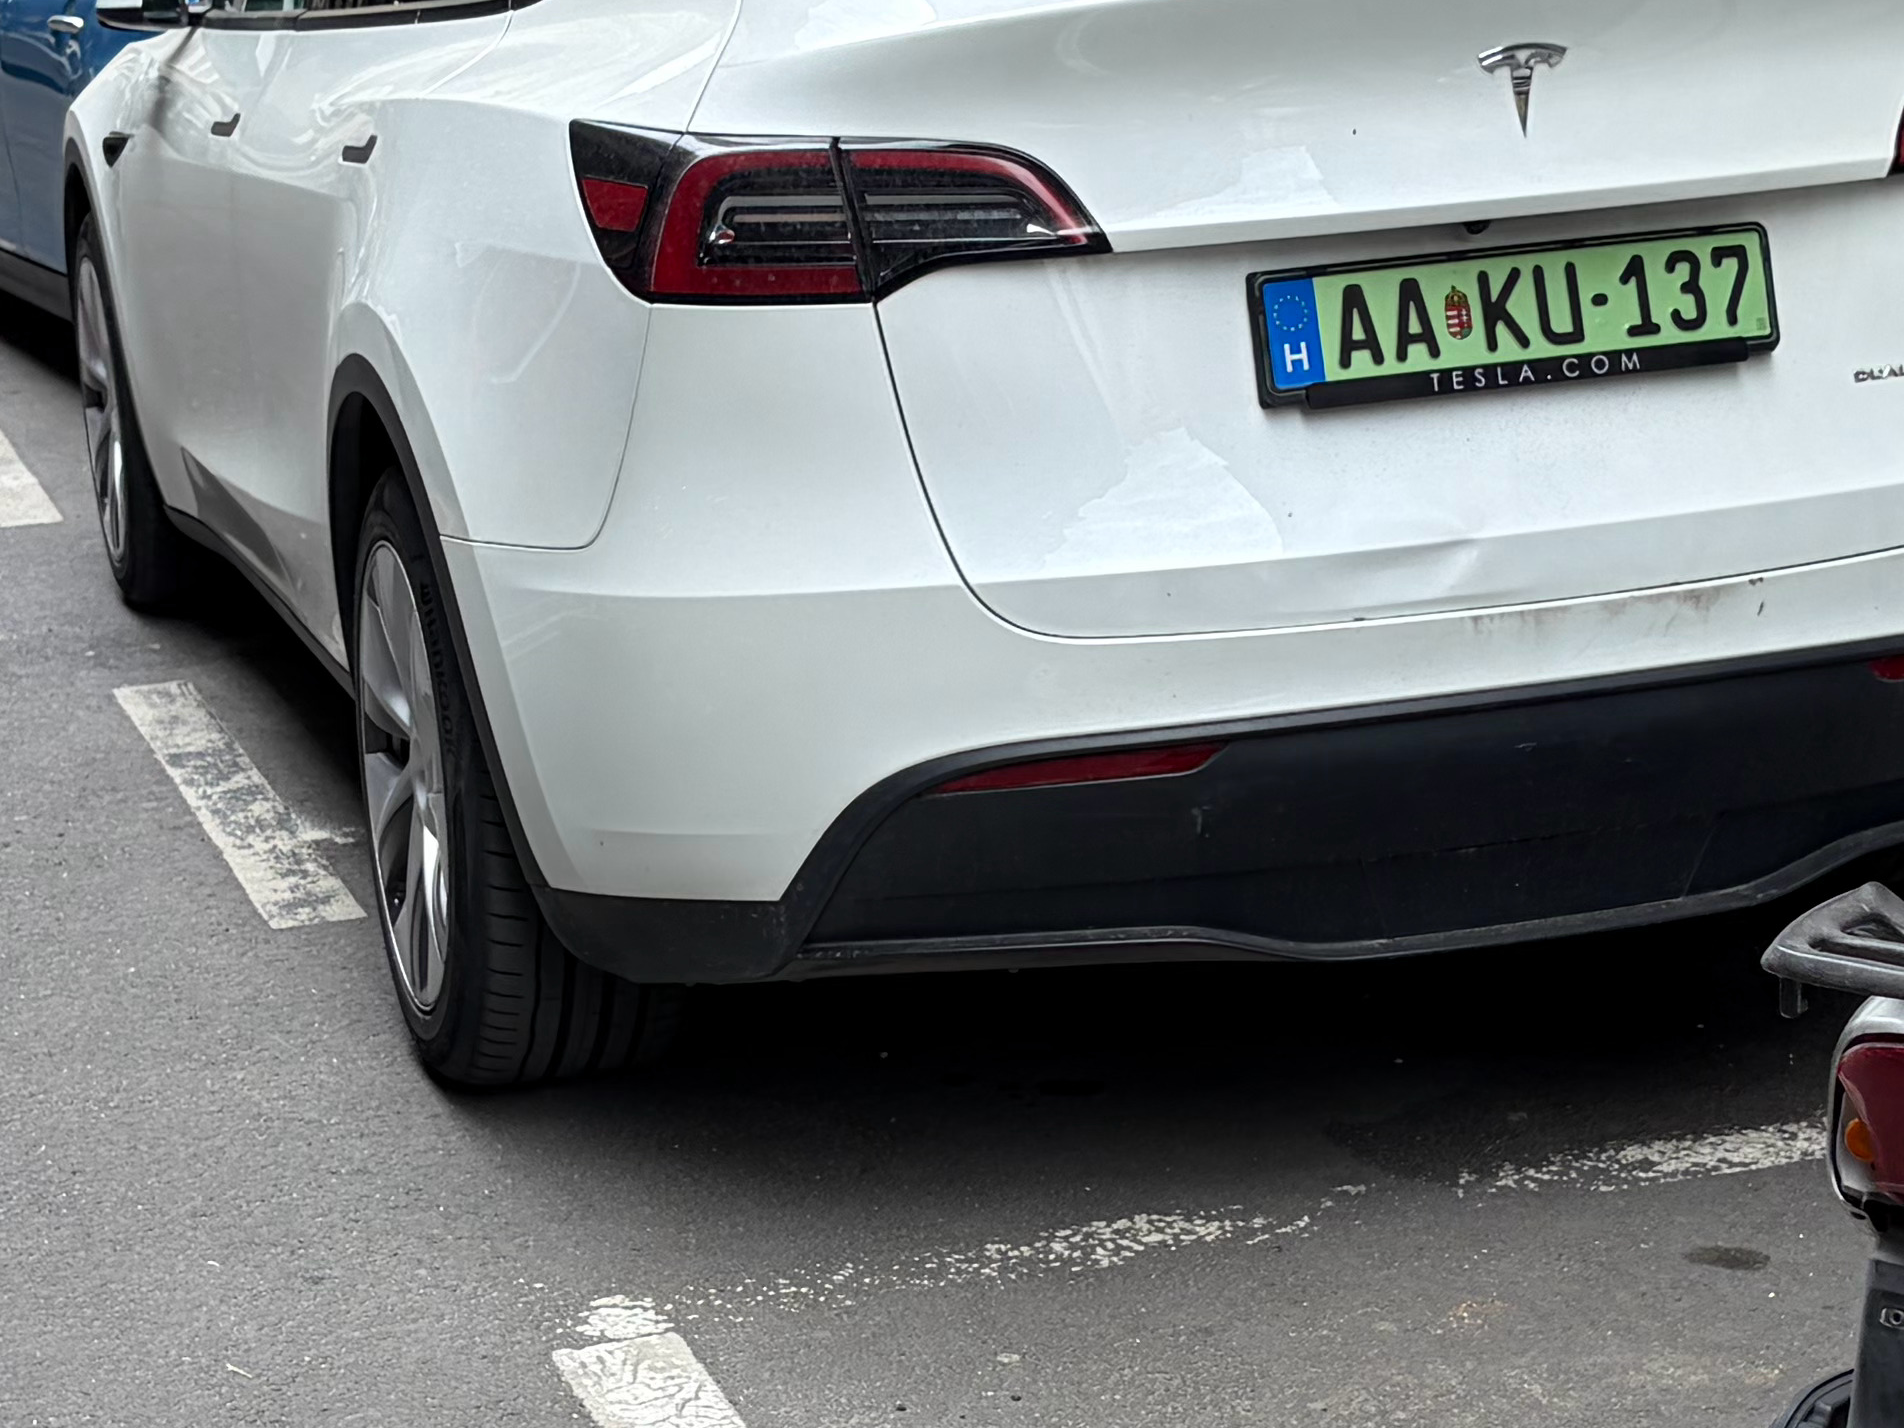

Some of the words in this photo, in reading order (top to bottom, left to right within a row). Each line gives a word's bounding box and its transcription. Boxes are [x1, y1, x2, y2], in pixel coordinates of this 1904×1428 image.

[1337, 277, 1441, 370] AA
[1477, 243, 1751, 354] KU-137
[1283, 340, 1311, 374] H
[1429, 350, 1643, 393] TESLA.COM
